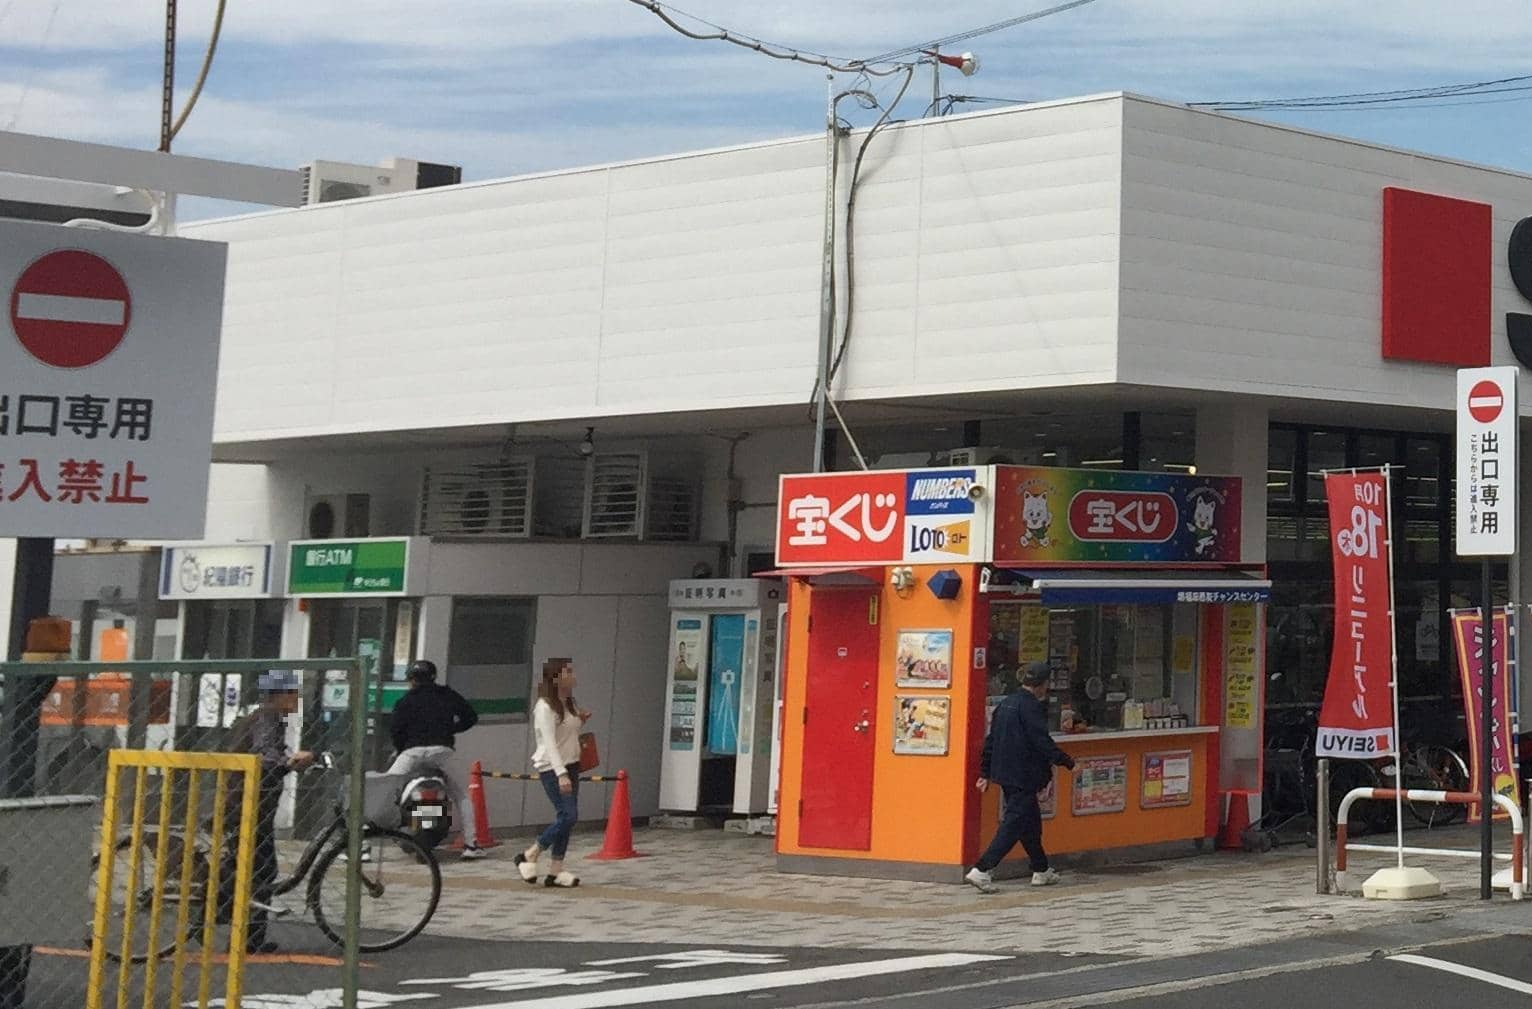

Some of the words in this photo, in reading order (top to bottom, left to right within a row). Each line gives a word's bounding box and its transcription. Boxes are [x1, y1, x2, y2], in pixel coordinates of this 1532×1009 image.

[0, 394, 153, 441] 口専用
[0, 459, 149, 504] 入禁止
[911, 477, 972, 501] NUMBERS
[1480, 430, 1499, 534] 出口専用
[788, 492, 898, 546] 宝くじ
[911, 524, 945, 553] LOTO
[1087, 499, 1161, 533] 宝くじ
